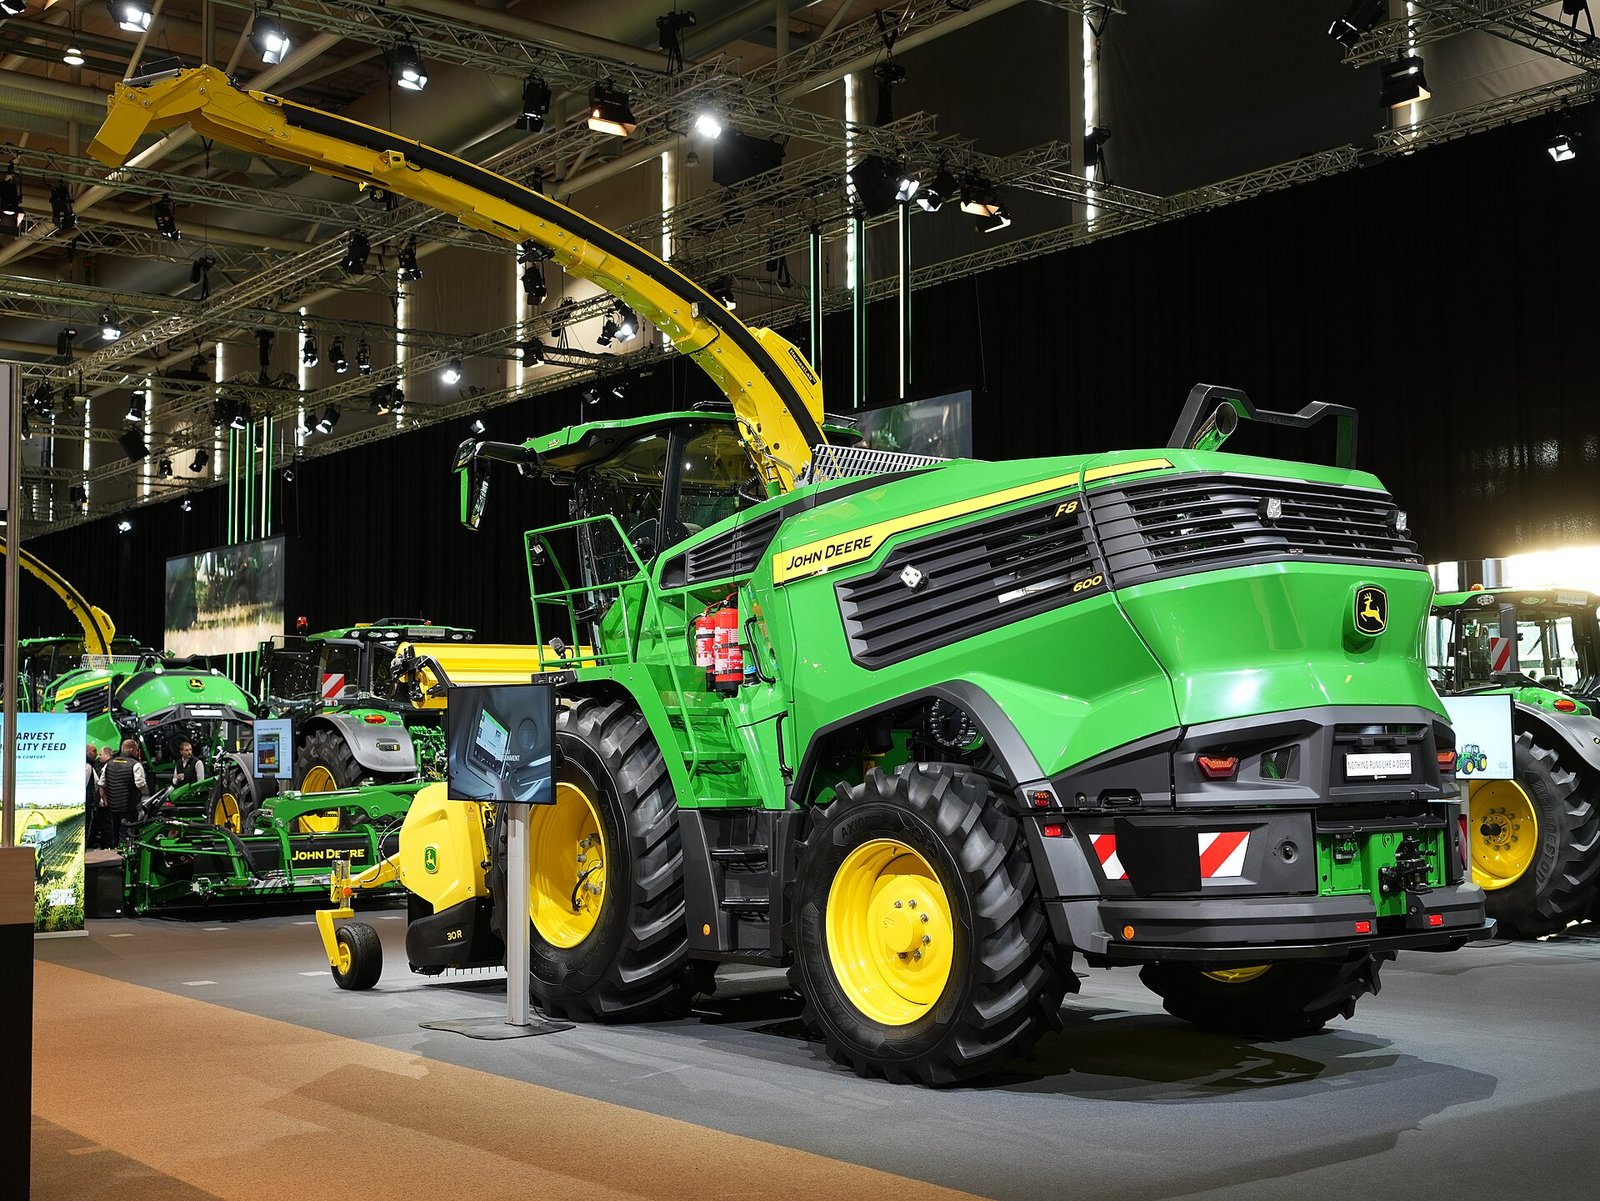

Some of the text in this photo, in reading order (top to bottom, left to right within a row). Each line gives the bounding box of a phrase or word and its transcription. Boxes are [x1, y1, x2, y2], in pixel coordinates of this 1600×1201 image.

[1055, 501, 1078, 517] F8
[786, 535, 872, 571] JOHN DEERE
[1073, 575, 1102, 592] 600
[16, 732, 54, 741] ARVEST
[17, 743, 67, 751] LITY FEED
[292, 848, 365, 861] JOHN DERE
